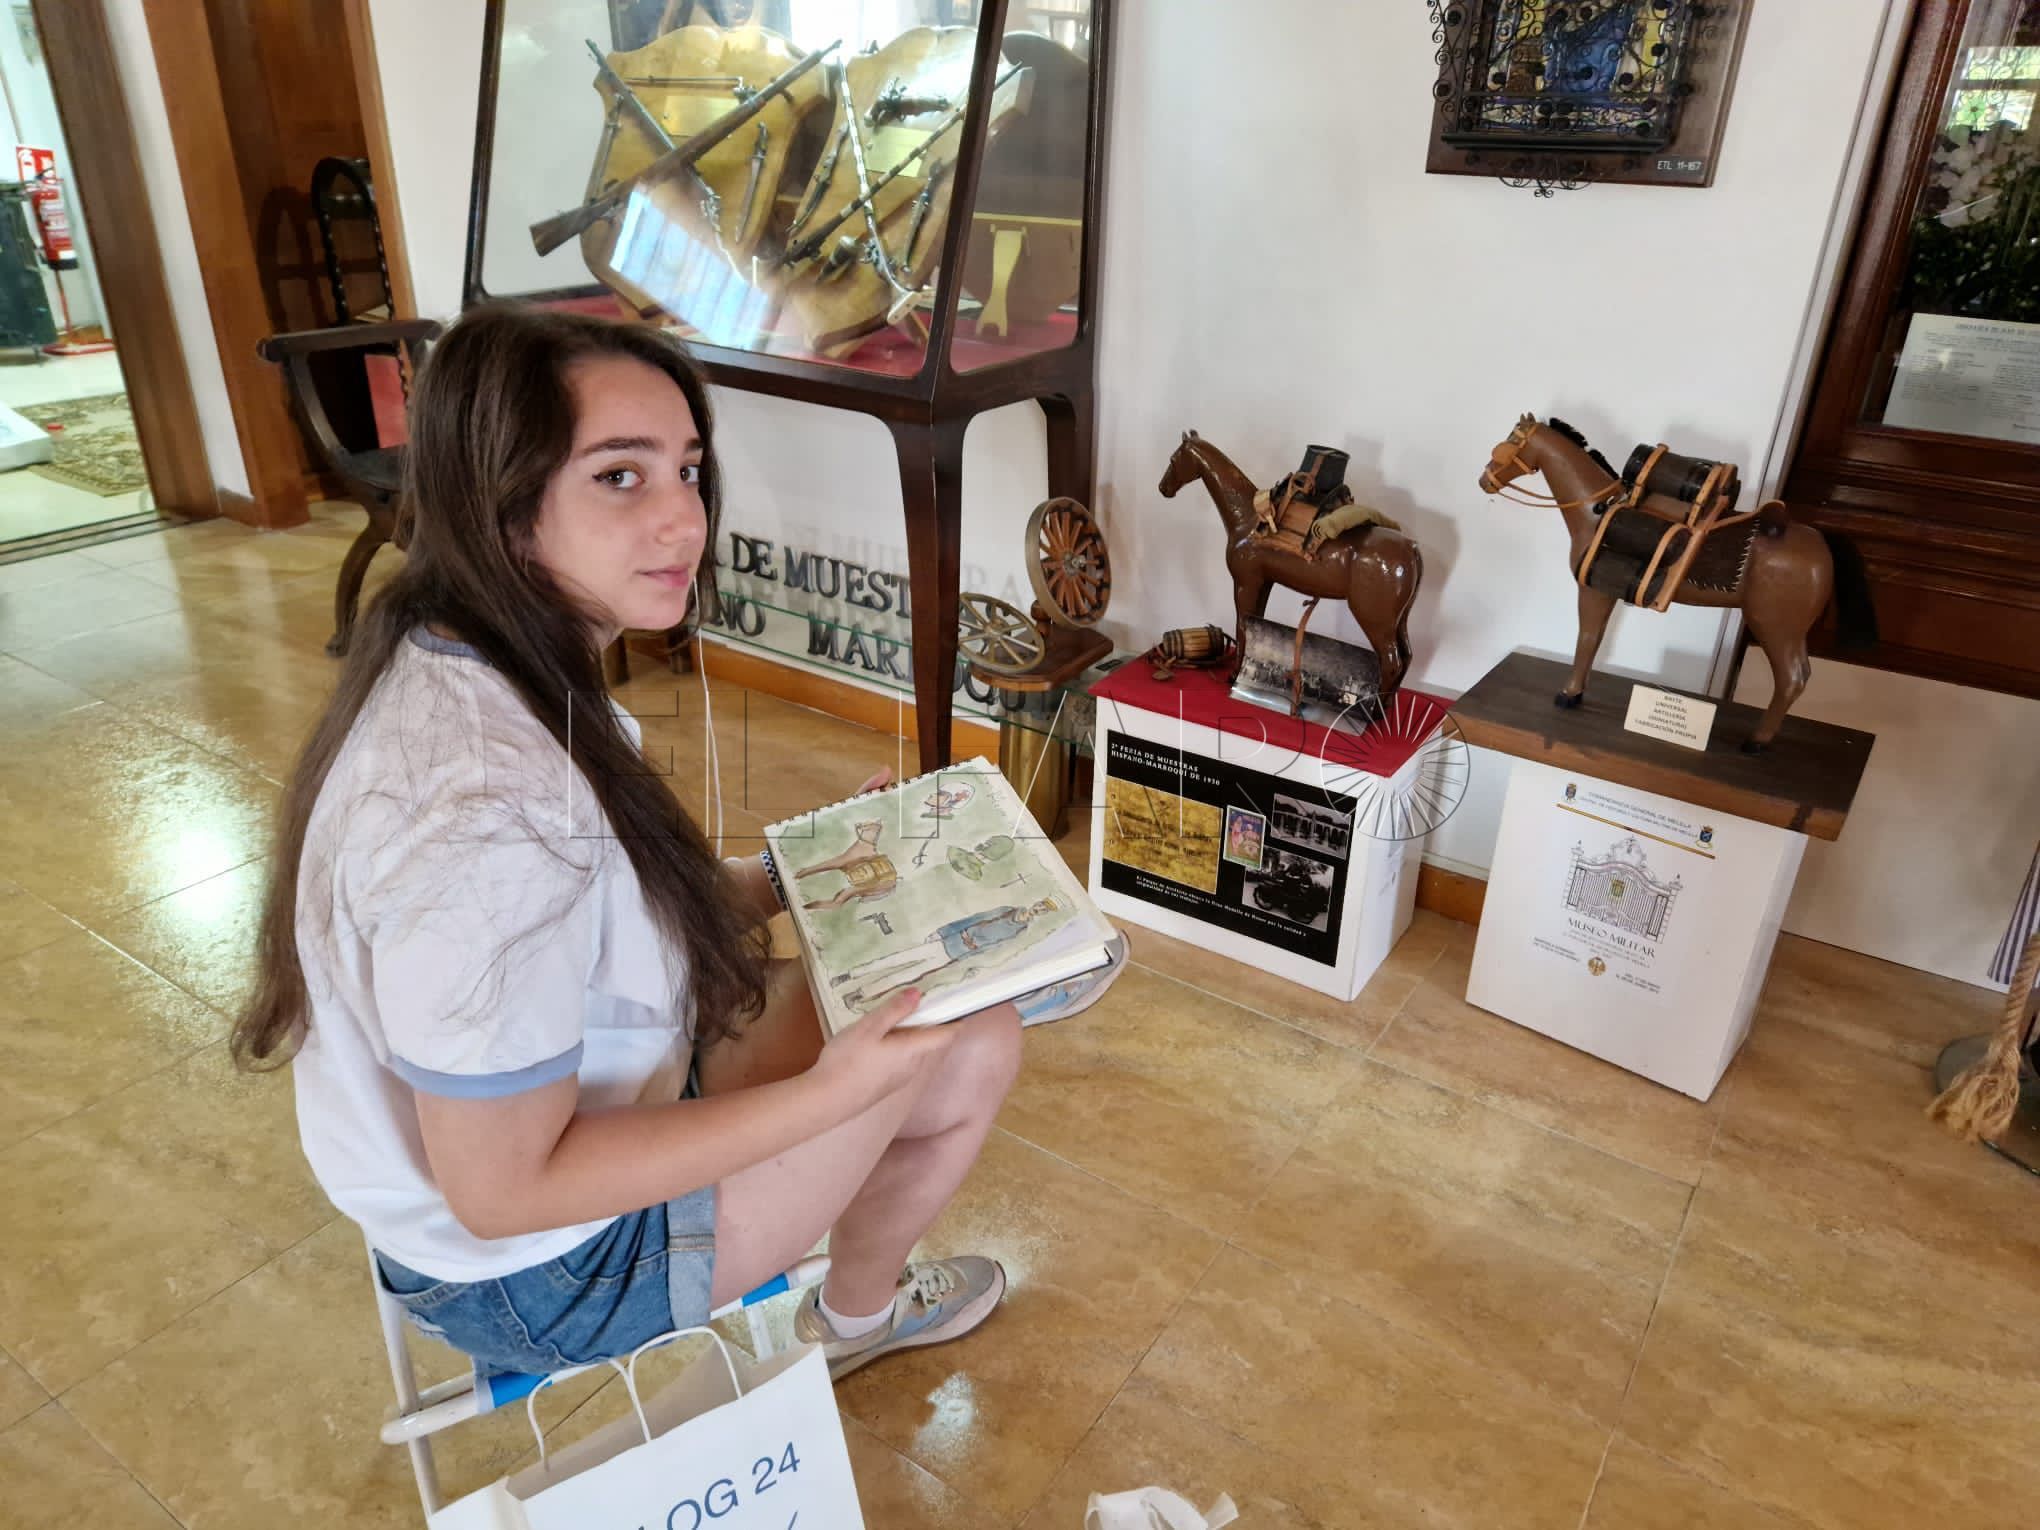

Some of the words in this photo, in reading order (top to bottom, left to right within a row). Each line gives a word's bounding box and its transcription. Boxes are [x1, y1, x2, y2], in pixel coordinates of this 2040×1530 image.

[729, 531, 778, 581] DE
[1144, 751, 1155, 760] DE
[1156, 755, 1199, 772] MUESTRAS
[1190, 772, 1201, 781] DE
[1568, 917, 1608, 938] MUSEO
[1609, 932, 1656, 959] MILITAR
[751, 1441, 801, 1495] 24
